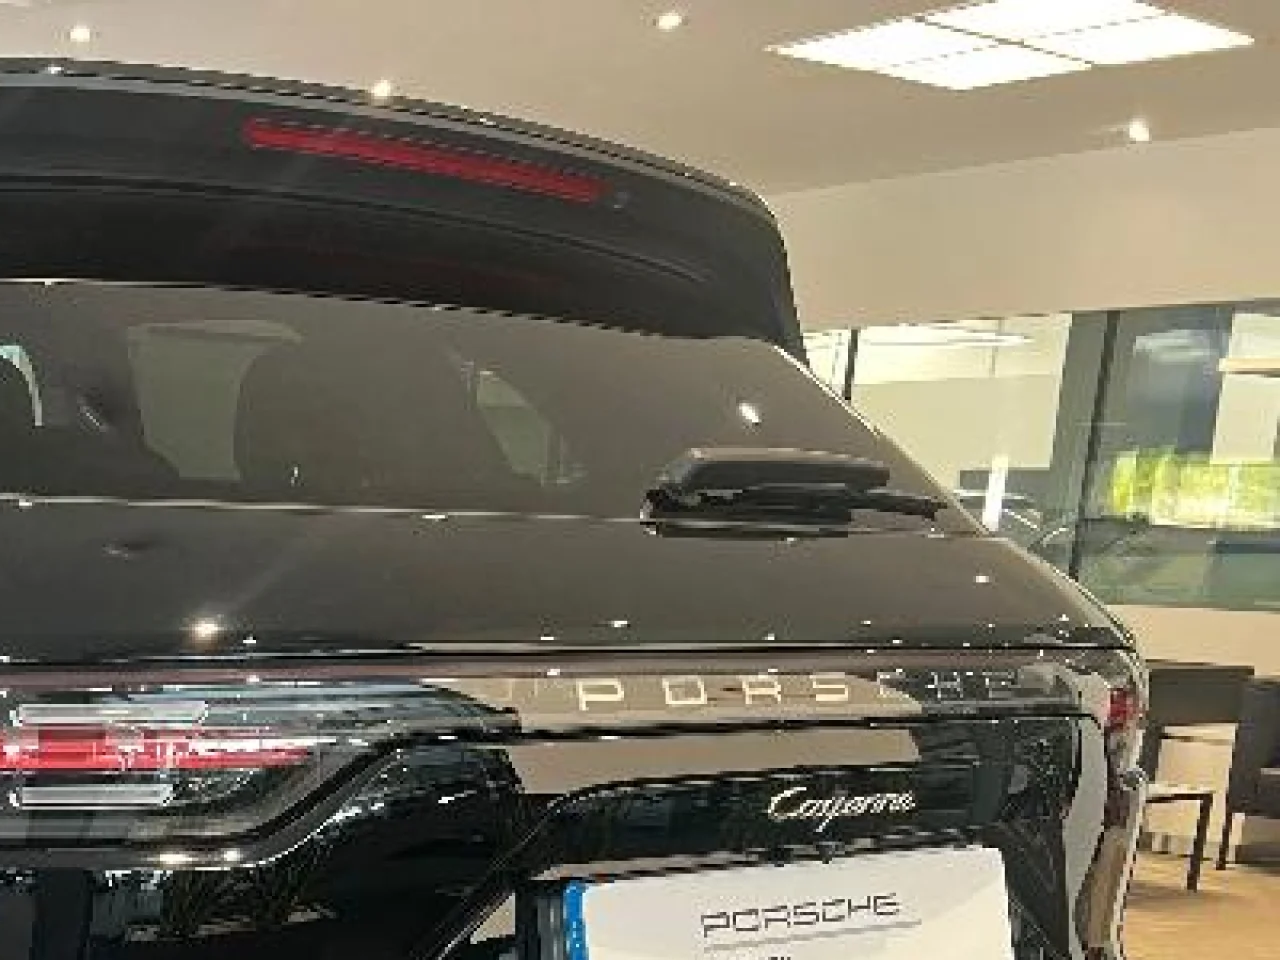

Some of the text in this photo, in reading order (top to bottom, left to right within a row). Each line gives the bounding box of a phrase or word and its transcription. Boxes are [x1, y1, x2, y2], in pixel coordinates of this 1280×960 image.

[576, 668, 1017, 712] PORSCHE
[768, 786, 916, 832] Cayenne
[701, 892, 901, 938] PORSCHE
